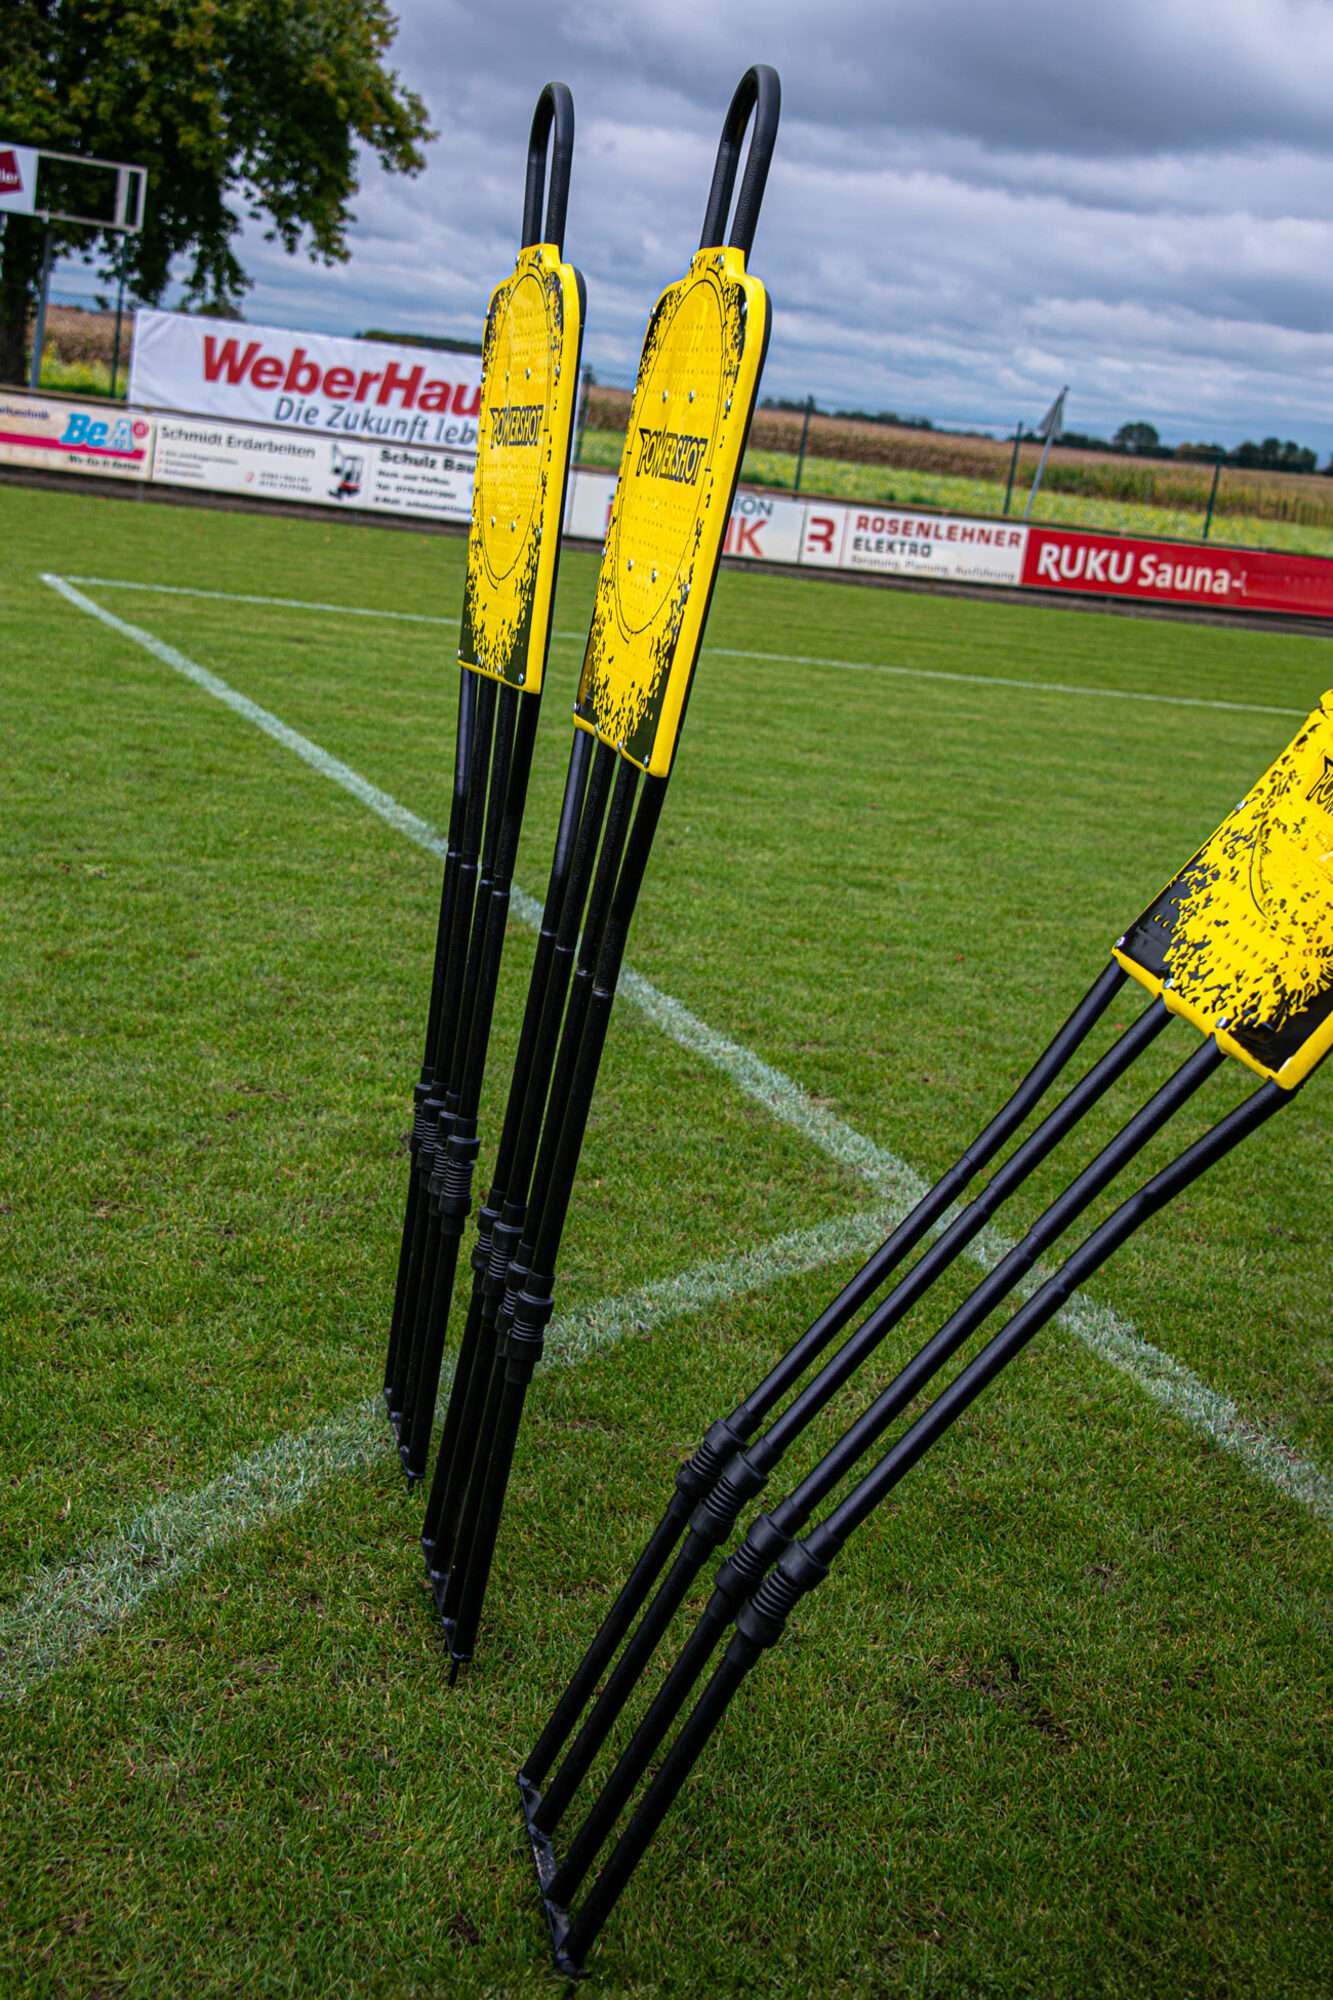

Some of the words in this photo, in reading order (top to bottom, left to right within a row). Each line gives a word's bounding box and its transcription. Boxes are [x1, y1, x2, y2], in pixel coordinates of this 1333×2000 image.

[59, 412, 135, 453] BeA
[273, 397, 320, 425] Die
[326, 404, 429, 444] Zukunft
[489, 402, 545, 450] POWERSHOT
[161, 426, 222, 447] Schmidt
[226, 434, 316, 459] Erdarbeiten
[380, 449, 437, 469] Schulz
[638, 425, 709, 486] POWERSHOT
[853, 537, 932, 559] ELEKTRO
[855, 514, 1023, 549] ROSENLEHNER
[1036, 542, 1136, 584] RUKU
